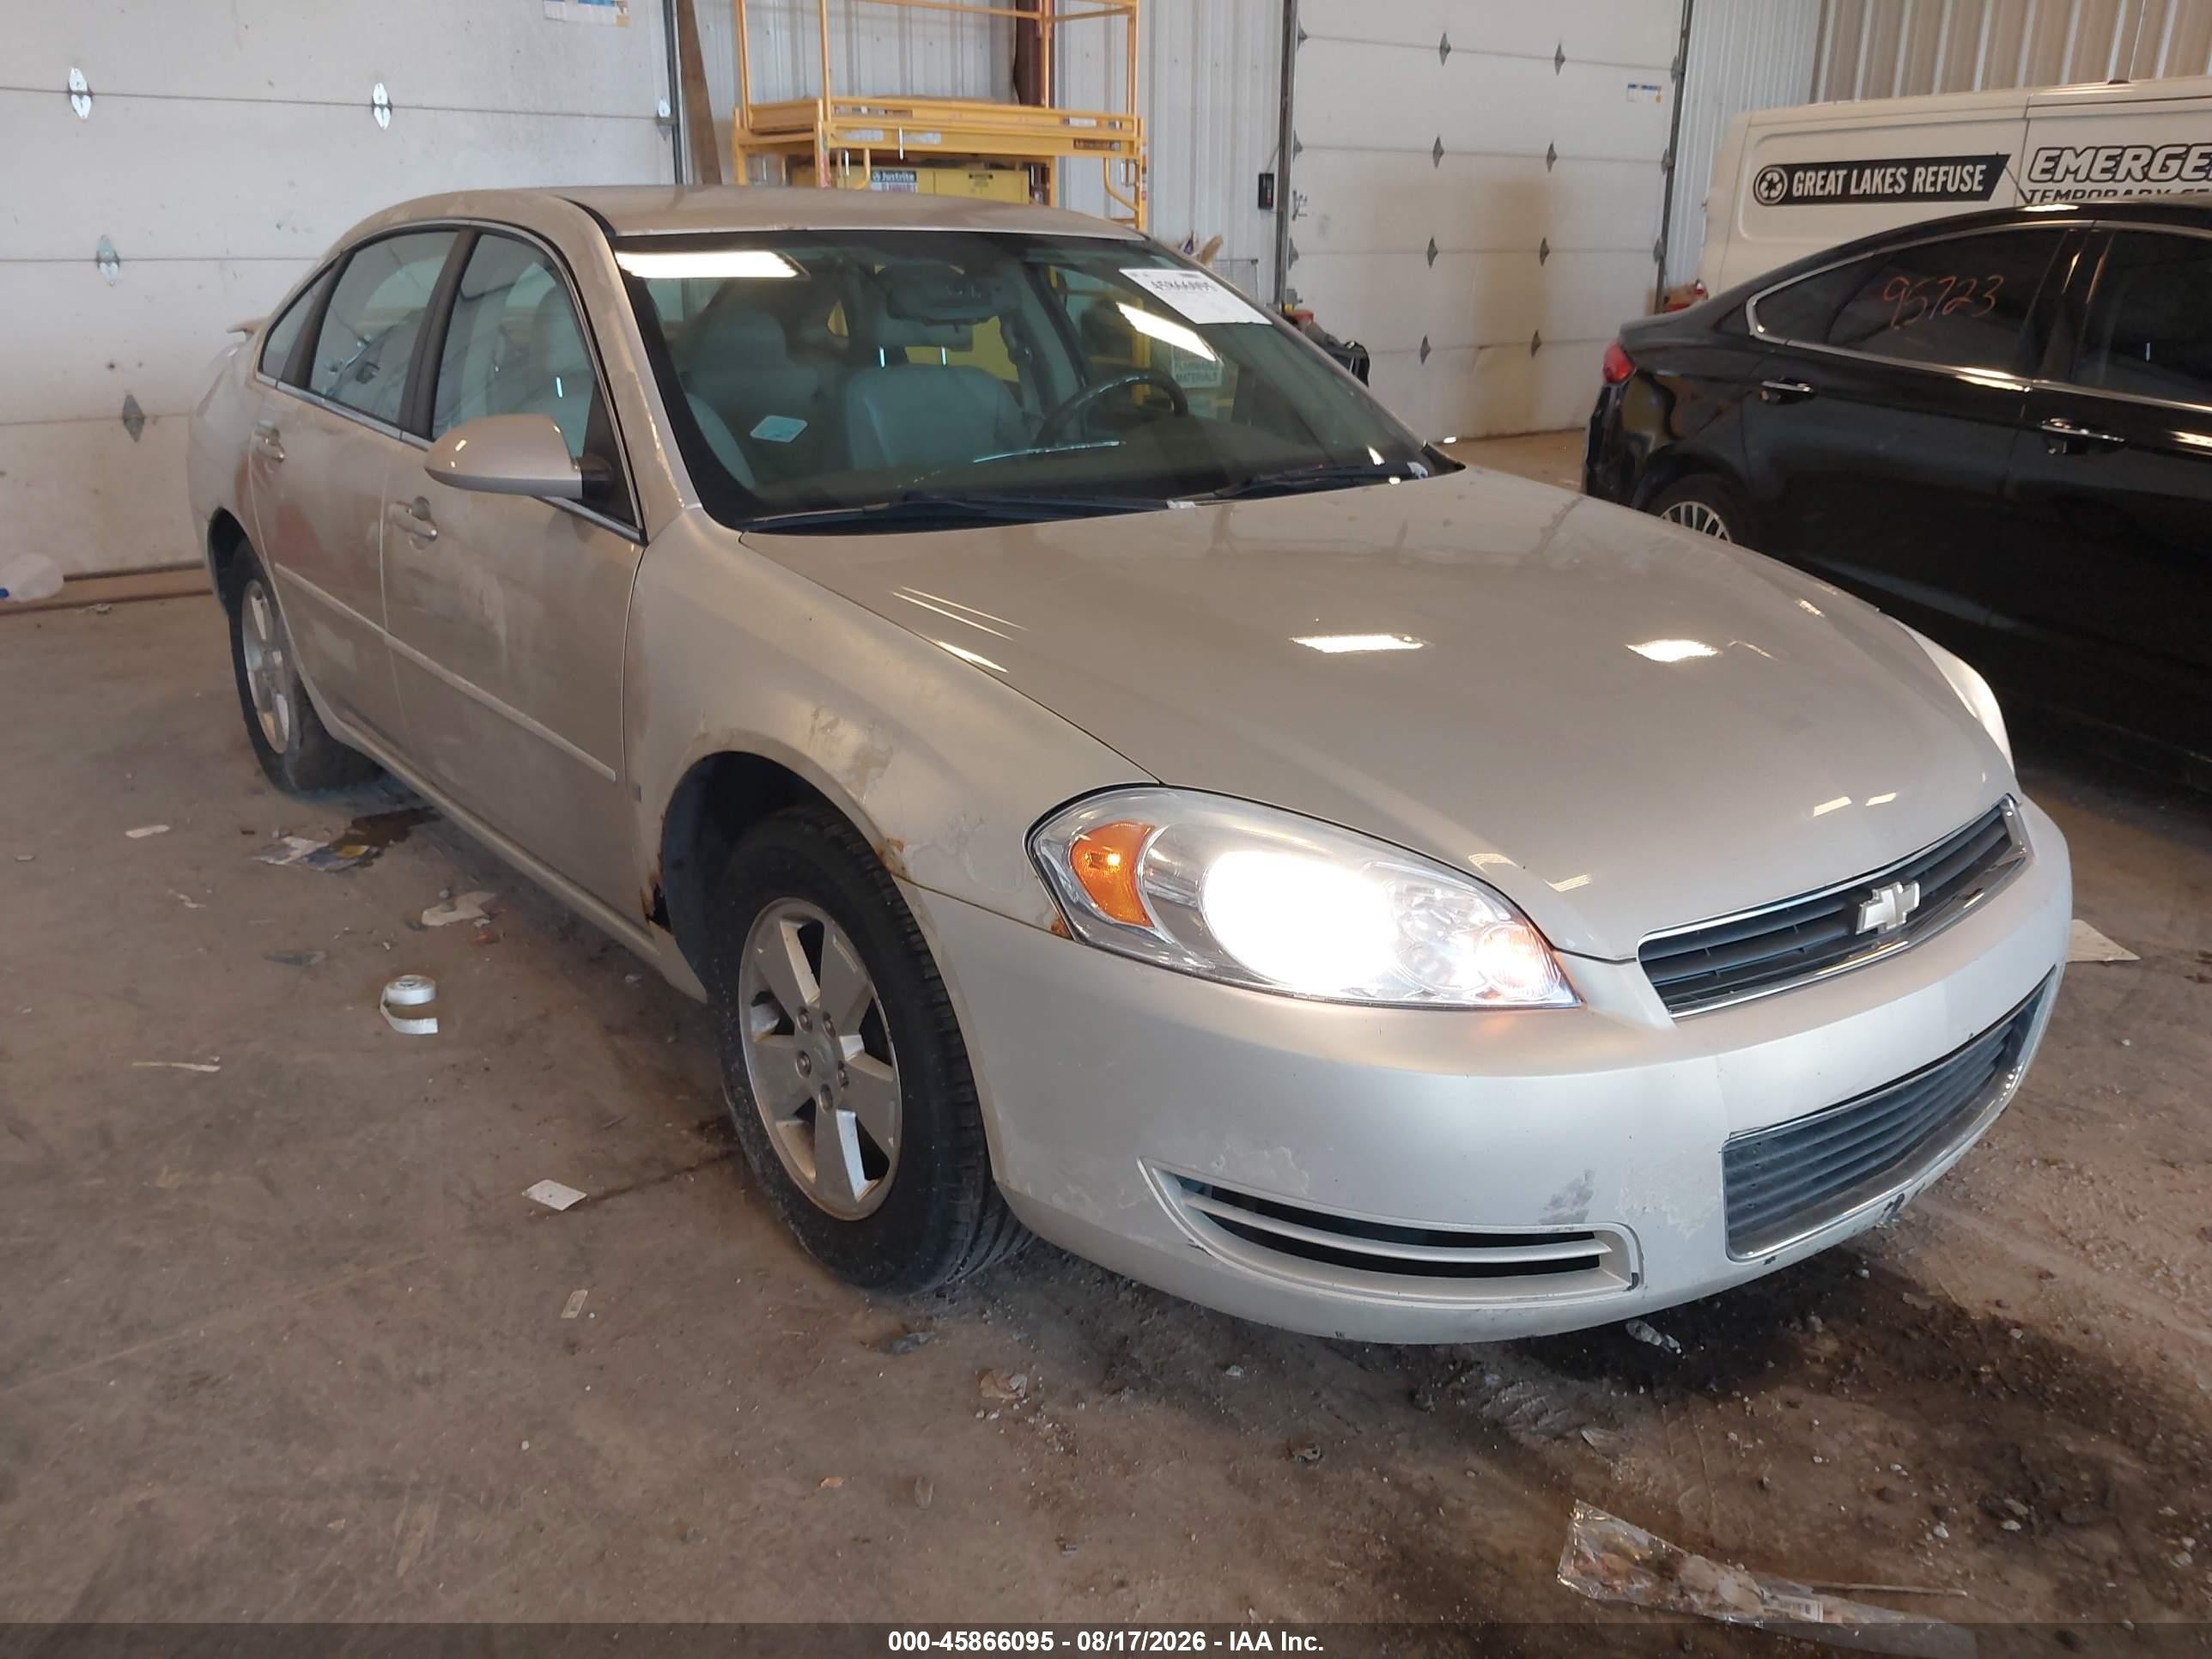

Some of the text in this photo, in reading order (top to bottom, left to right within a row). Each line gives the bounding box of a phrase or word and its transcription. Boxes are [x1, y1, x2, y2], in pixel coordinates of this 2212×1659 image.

[1792, 164, 1987, 198] GREAT LAKES REFUSE
[2027, 143, 2212, 184] EMERGE
[1883, 274, 2004, 331] 95723
